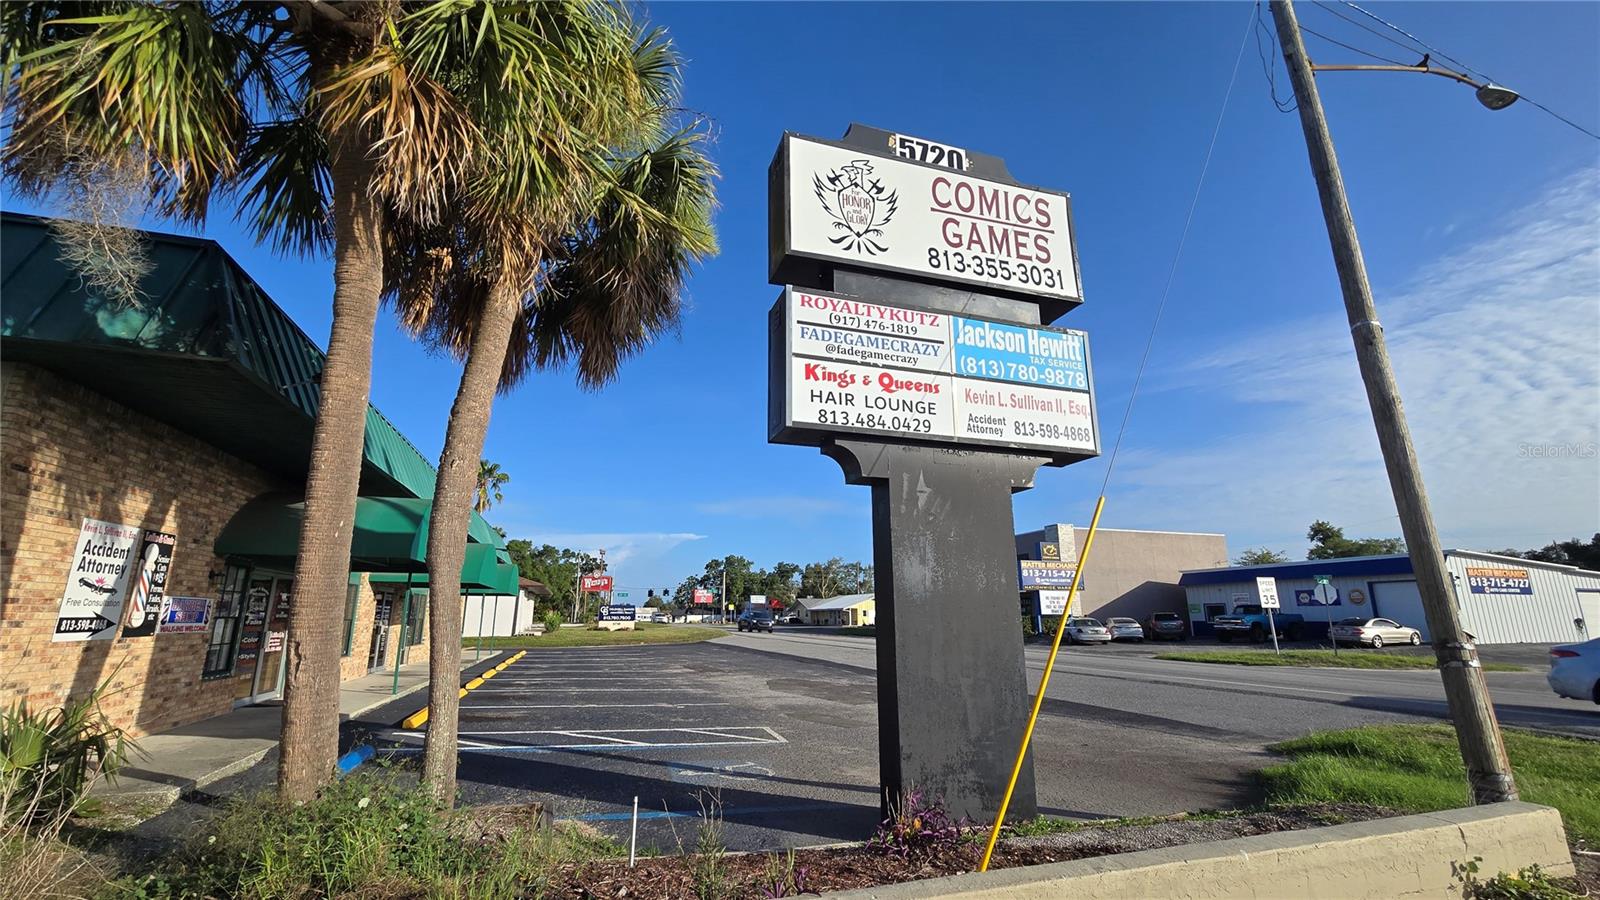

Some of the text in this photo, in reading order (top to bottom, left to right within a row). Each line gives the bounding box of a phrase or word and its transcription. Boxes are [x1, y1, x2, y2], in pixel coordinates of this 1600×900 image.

[899, 137, 963, 170] 5720
[851, 187, 860, 195] For
[931, 176, 1051, 228] COMICS
[841, 193, 871, 214] HONOR
[846, 211, 869, 225] GLORY
[941, 217, 1051, 264] GAMES
[928, 247, 1064, 290] 813-355-3031
[799, 294, 940, 327] ROYALTYKUTZ
[829, 312, 917, 335] (917) 476-1819
[800, 326, 941, 357] FADEGAMECRAZY
[956, 318, 1082, 361] Jackson Hewitt
[825, 343, 919, 366] @fadegamecrazy
[1030, 356, 1083, 370] TAX SERVICE
[804, 362, 941, 394] Kings & Queens
[960, 355, 1086, 387] (813) 780-9878
[810, 389, 937, 415] HAIR LOUNGE
[965, 387, 996, 406] Kevin
[998, 391, 1008, 408] L.
[1010, 393, 1053, 413] Sullivan
[1055, 398, 1067, 416] II,
[818, 409, 932, 433] 813.484.0429
[966, 423, 1004, 437] Attorney
[968, 412, 1007, 426] Accident
[1014, 420, 1091, 442] 813-598-4868
[82, 539, 130, 560] Accident
[77, 556, 127, 579] Attorney
[1022, 569, 1078, 577] 813-715-472
[1468, 568, 1493, 576] MASTER
[1470, 577, 1529, 588] 813-715-4727
[66, 597, 120, 607] Free Consultation
[1263, 595, 1277, 605] 35
